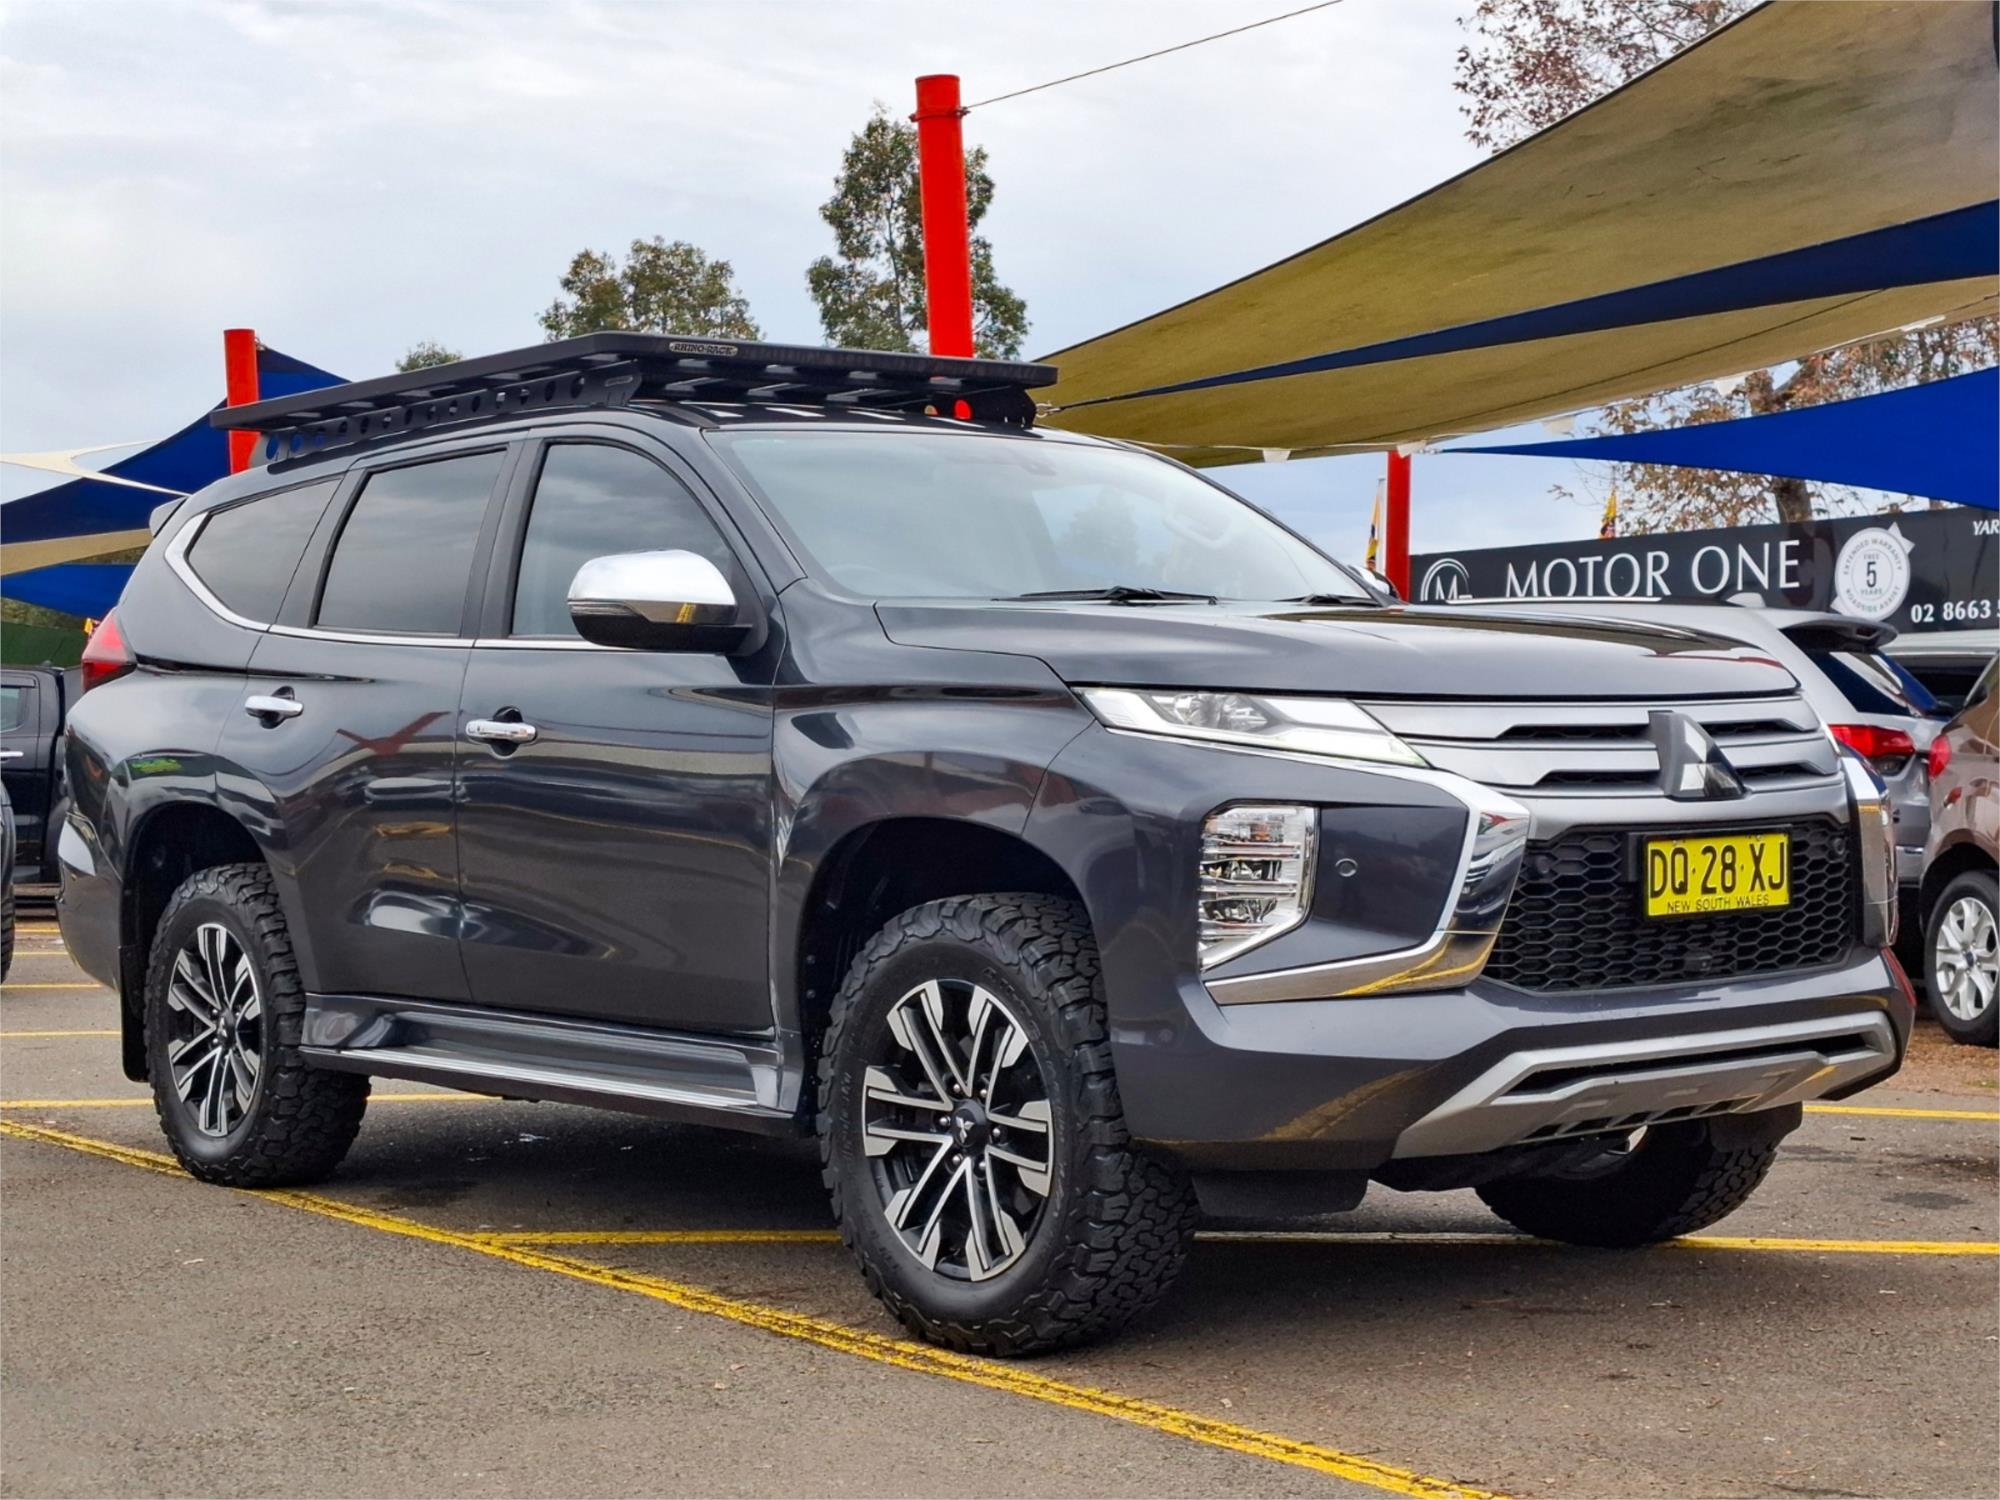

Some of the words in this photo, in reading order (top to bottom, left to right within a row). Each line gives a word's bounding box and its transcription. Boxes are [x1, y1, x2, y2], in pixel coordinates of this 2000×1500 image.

[1872, 538, 1902, 570] WARRANTY
[1505, 551, 1671, 598] MOTOR
[1691, 540, 1800, 594] ONE
[1866, 561, 1877, 588] 5
[1911, 604, 1934, 623] 02
[1943, 600, 1991, 622] 8663
[1667, 901, 1691, 913] NEW
[1696, 897, 1731, 911] SOUTH
[1736, 894, 1770, 907] WALES
